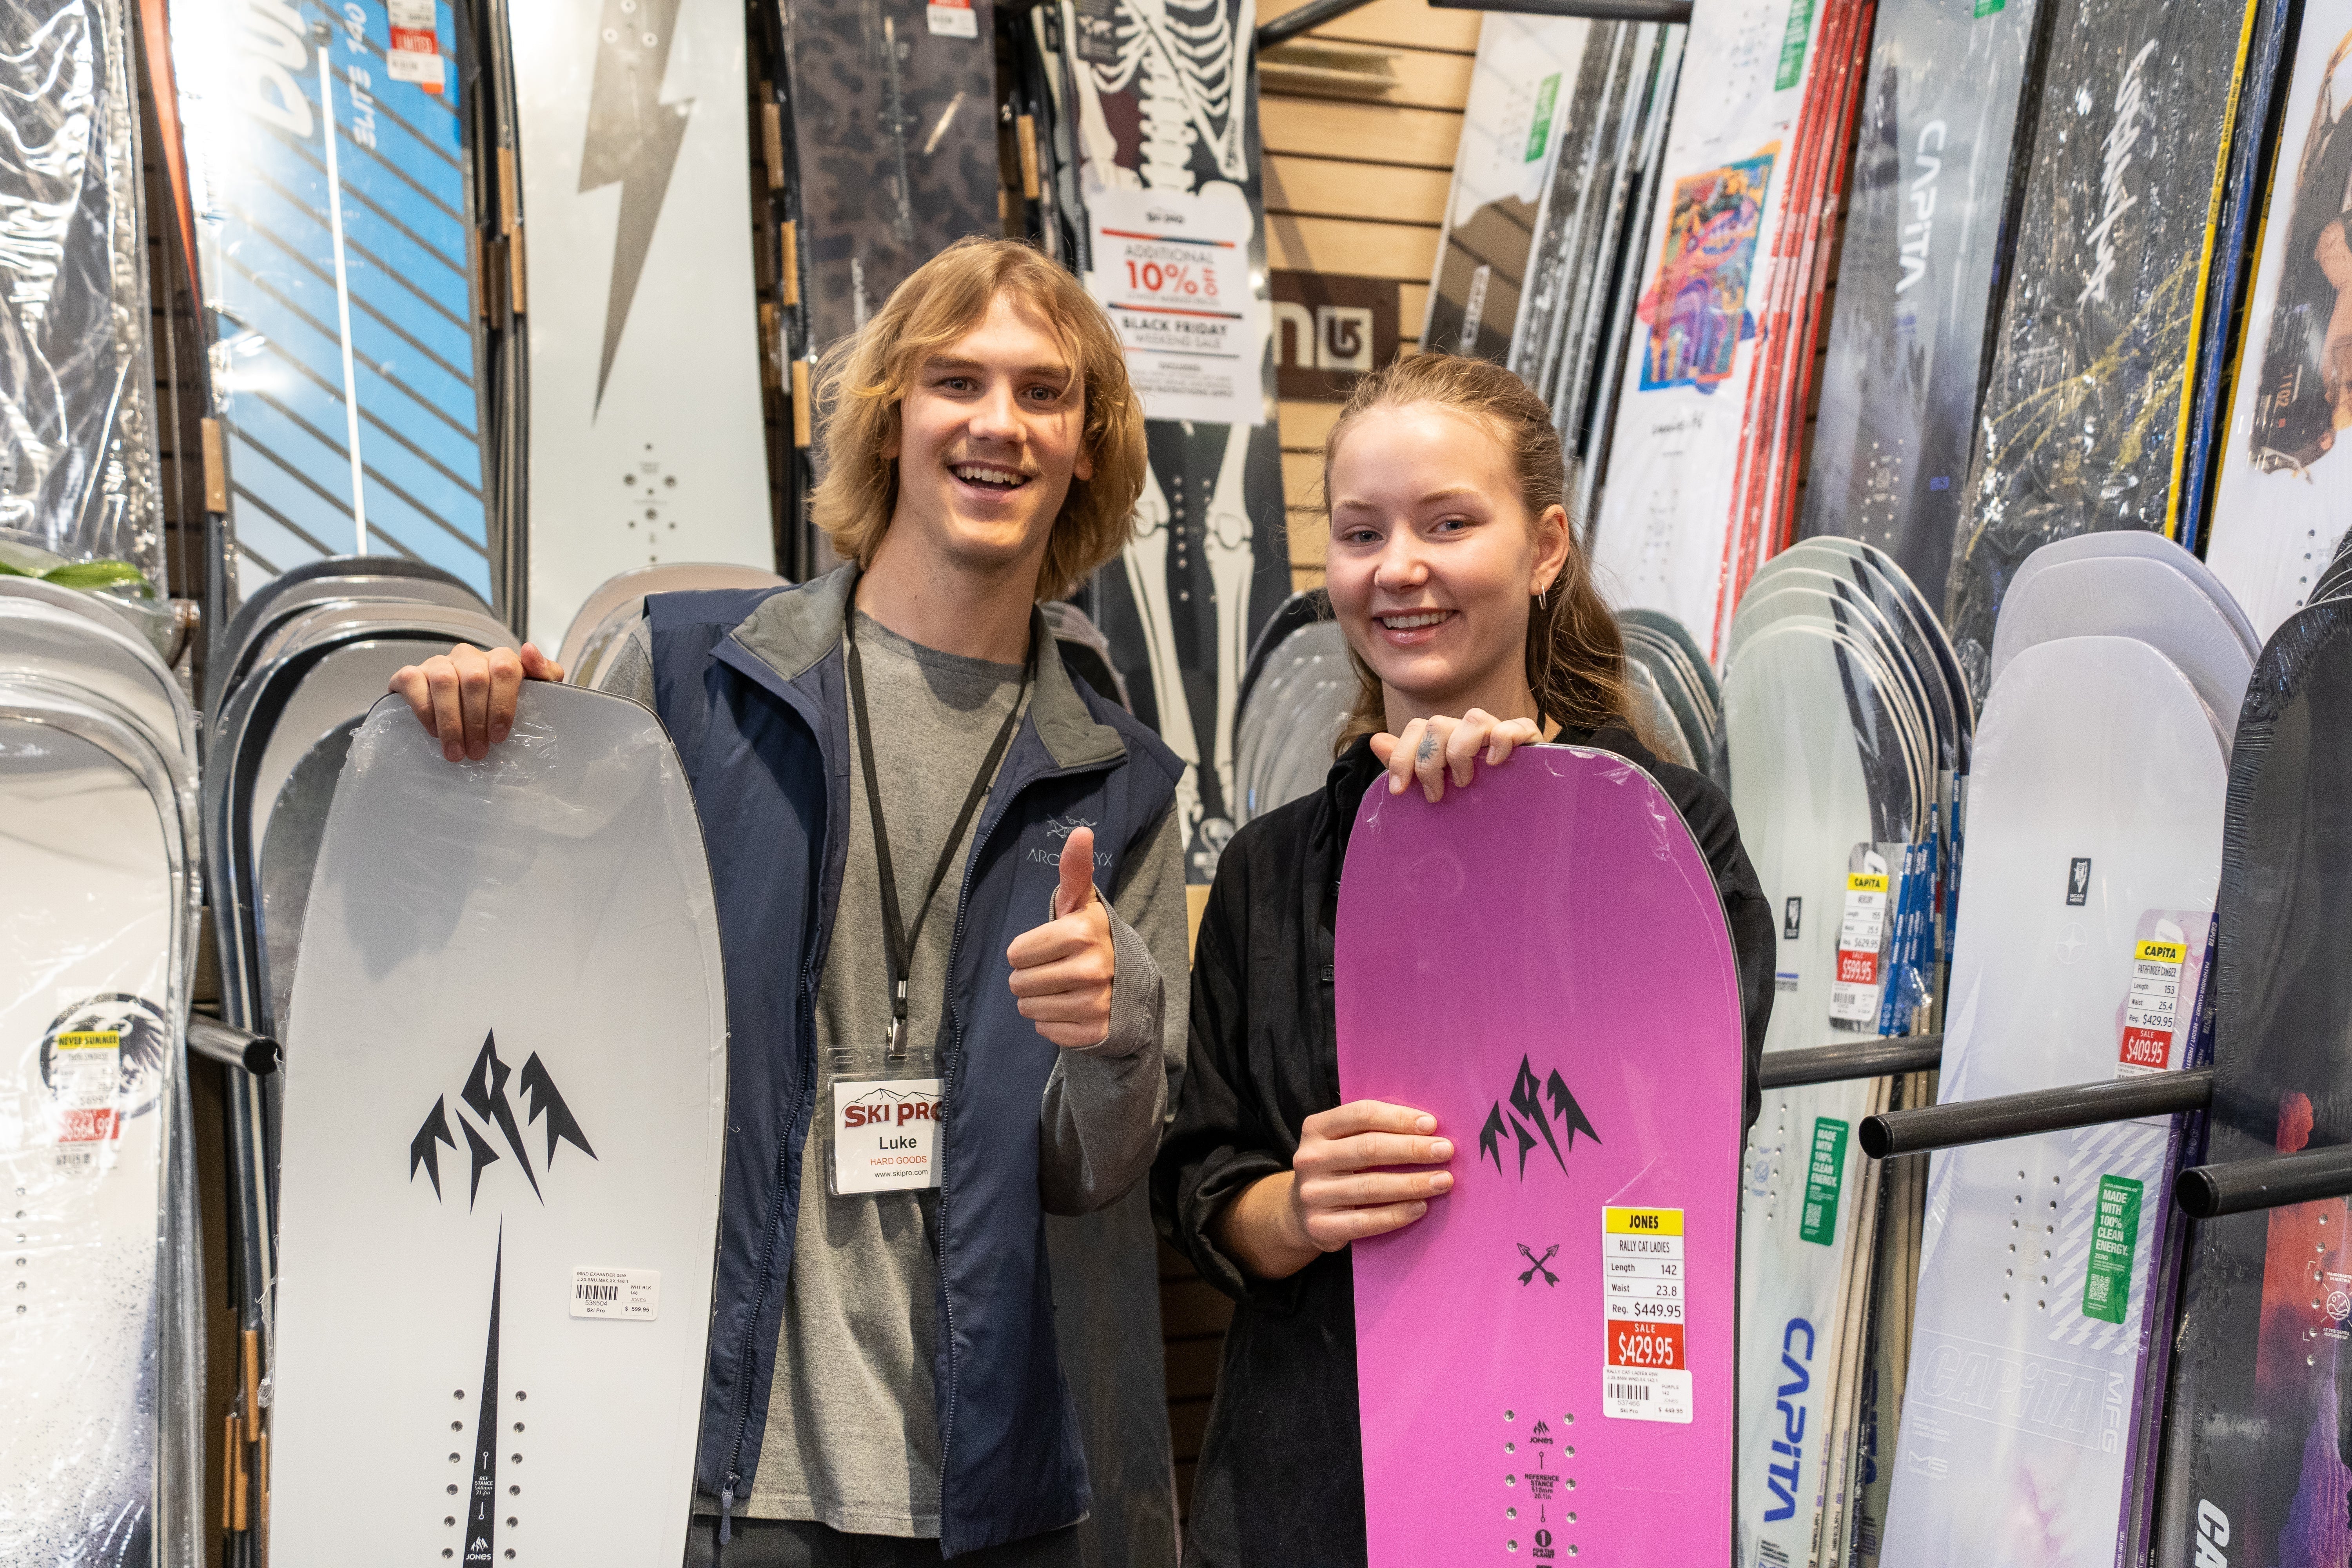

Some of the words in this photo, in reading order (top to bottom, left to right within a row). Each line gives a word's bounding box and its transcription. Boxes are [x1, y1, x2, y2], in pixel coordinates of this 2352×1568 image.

[344, 2, 368, 54] 140
[347, 65, 376, 150] ELITE
[1125, 244, 1214, 263] ADDITIONAL
[1126, 260, 1198, 294] 10%
[1203, 267, 1218, 297] OFF
[1122, 316, 1171, 331] BLACK
[1175, 321, 1228, 335] FRIDAY
[1136, 334, 1191, 347] WEEKEND
[1195, 336, 1221, 349] SALE
[1842, 957, 1872, 982] $599.95
[2138, 964, 2161, 976] PATHFINDER
[2161, 966, 2176, 977] CAMBER
[2201, 961, 2210, 994] PATHFINDER
[2165, 985, 2175, 995] 153
[2158, 1001, 2172, 1011] 25.4
[2142, 1014, 2172, 1028] $429.95
[59, 1034, 83, 1046] NEVER
[85, 1034, 118, 1045] SUMMER
[2140, 1030, 2154, 1038] SALE
[2127, 1036, 2164, 1064] $409.95
[844, 1102, 890, 1129] SKI
[879, 1136, 917, 1150] Luke
[870, 1157, 894, 1166] HARD
[896, 1155, 927, 1165] GOODS
[874, 1169, 928, 1178] www.skipro.com
[2103, 1189, 2127, 1204] MADE
[2101, 1201, 2122, 1216] WITH
[1629, 1214, 1659, 1229] JONES
[2100, 1214, 2122, 1229] 100%
[2097, 1227, 2124, 1242] CLEAN
[1620, 1240, 1636, 1252] RALLY
[1638, 1241, 1648, 1252] CAT
[1650, 1241, 1670, 1253] LADIES
[2096, 1239, 2128, 1256] ENERGY.
[1611, 1263, 1635, 1272] Length
[1661, 1264, 1677, 1275] 142
[1612, 1283, 1630, 1292] Waist
[1656, 1285, 1677, 1296] 23.8
[1612, 1304, 1628, 1314] Reg.
[1635, 1301, 1681, 1318] $449.95
[1634, 1323, 1656, 1334] SALE
[1618, 1331, 1674, 1366] $429.95
[2102, 1371, 2125, 1455] MFG
[1524, 1473, 1559, 1481] REFERENCE
